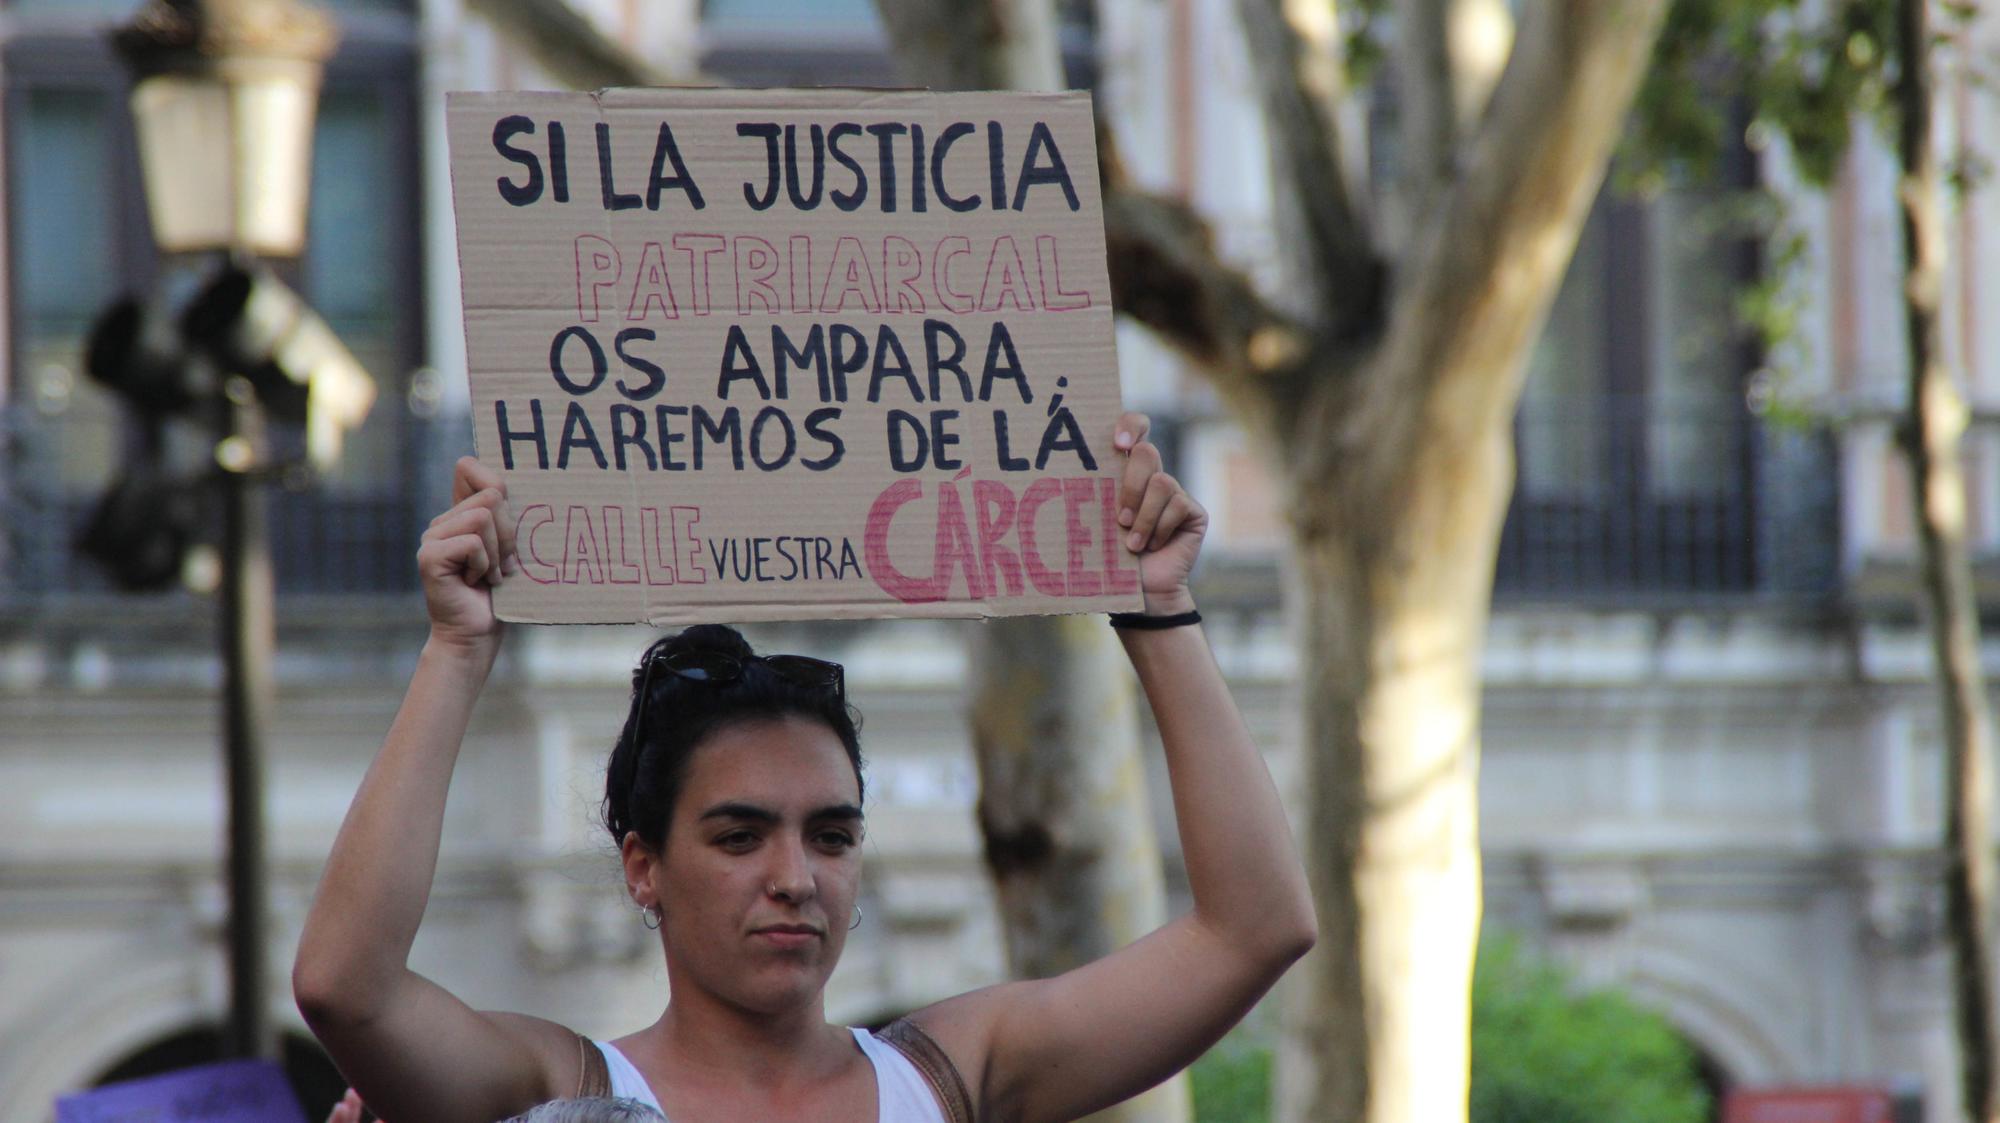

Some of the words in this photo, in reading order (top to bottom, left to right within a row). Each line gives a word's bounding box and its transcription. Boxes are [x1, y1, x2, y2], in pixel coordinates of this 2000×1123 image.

[492, 115, 569, 207] SI
[595, 121, 706, 211] LA
[736, 120, 1081, 213] JUSTICIA
[574, 233, 1092, 322] PATRIARCAL
[550, 326, 666, 401] OS
[495, 398, 847, 472] HAREMOS
[887, 409, 962, 473] DE
[514, 504, 706, 586] CALLE
[708, 536, 863, 581] VUESTRA
[864, 464, 1138, 605] CÁRCEL
